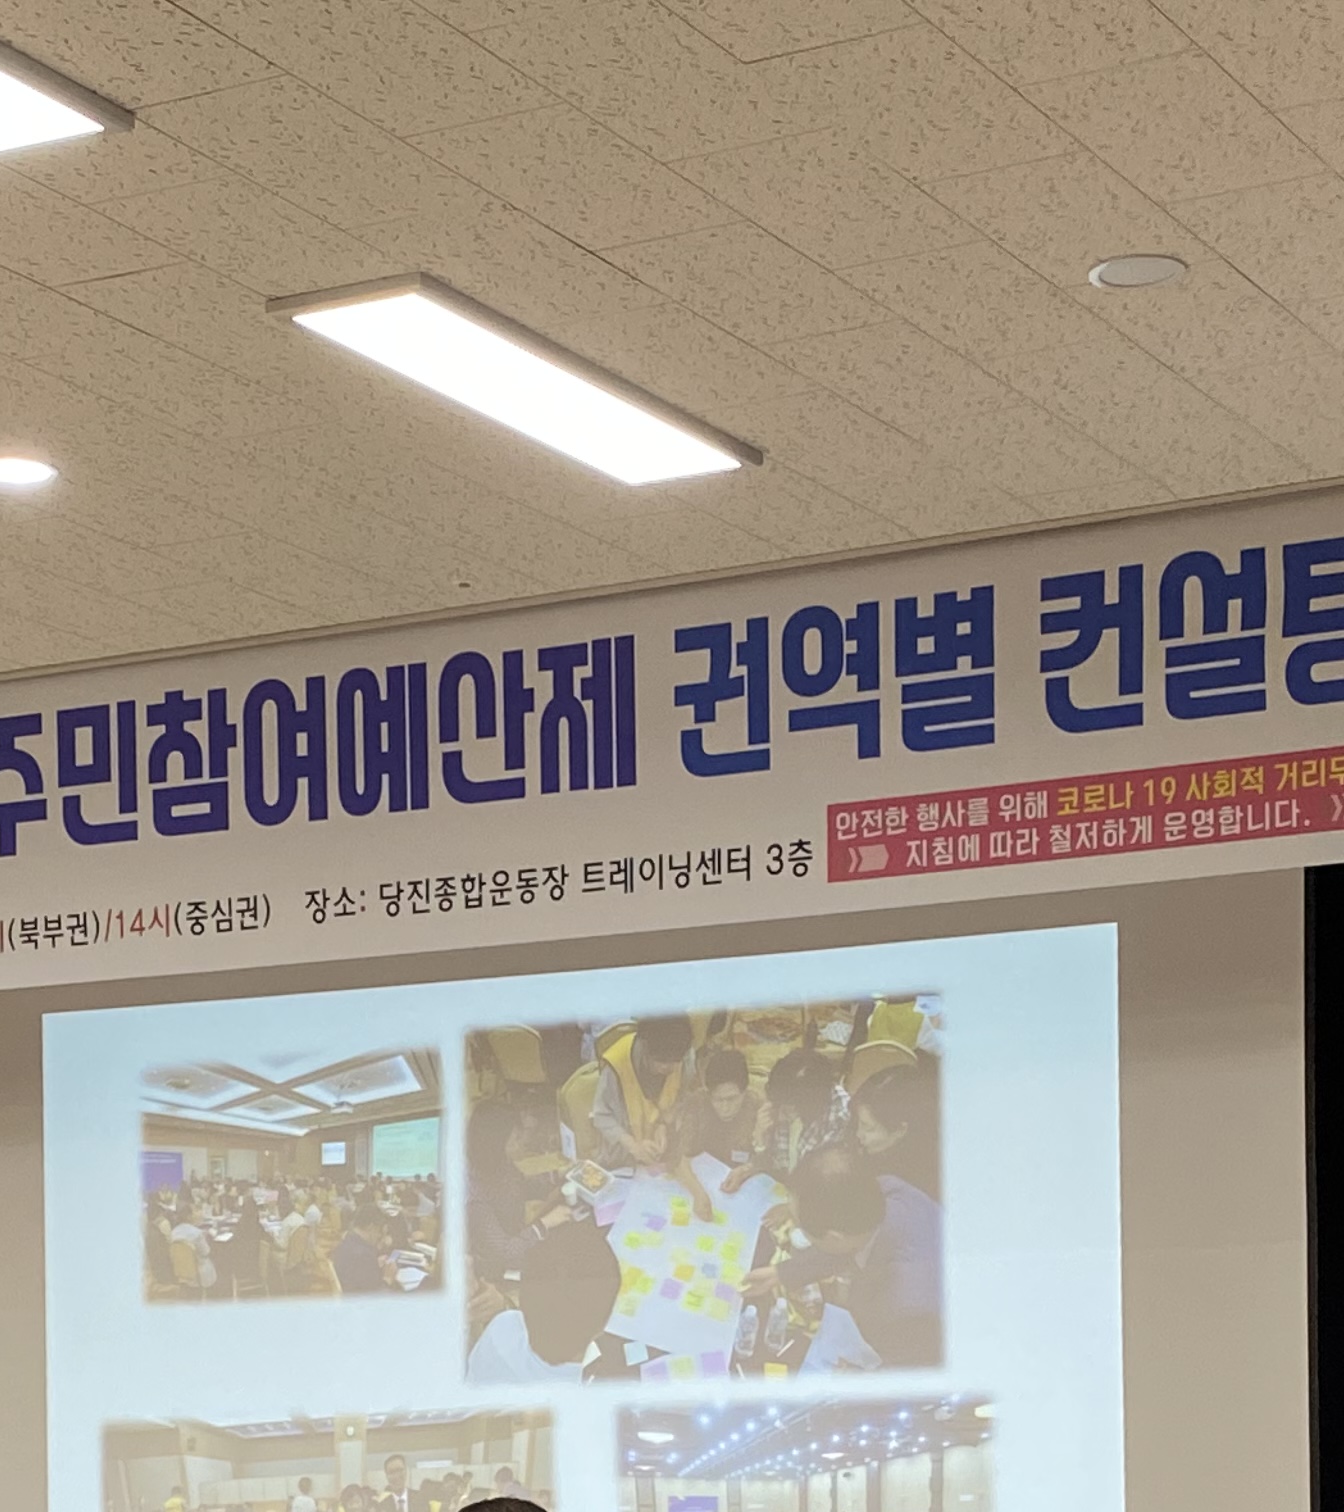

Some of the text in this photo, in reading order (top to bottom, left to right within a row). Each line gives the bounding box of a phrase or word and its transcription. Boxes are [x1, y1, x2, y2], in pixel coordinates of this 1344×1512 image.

[673, 584, 996, 778] 권역별
[835, 808, 908, 840] 안전한
[915, 797, 990, 832] 행사를
[998, 789, 1049, 822] 위해
[1057, 781, 1134, 817] 코로나
[1143, 777, 1177, 807] 19
[1186, 764, 1265, 803] 사회적
[905, 798, 1312, 871] 지침에 따라 철저하게 운영합니다.
[304, 888, 367, 924] 장소:
[378, 863, 570, 919] 당진종합운동장
[581, 843, 753, 896] 트레이닝센터
[765, 838, 813, 877] 3층
